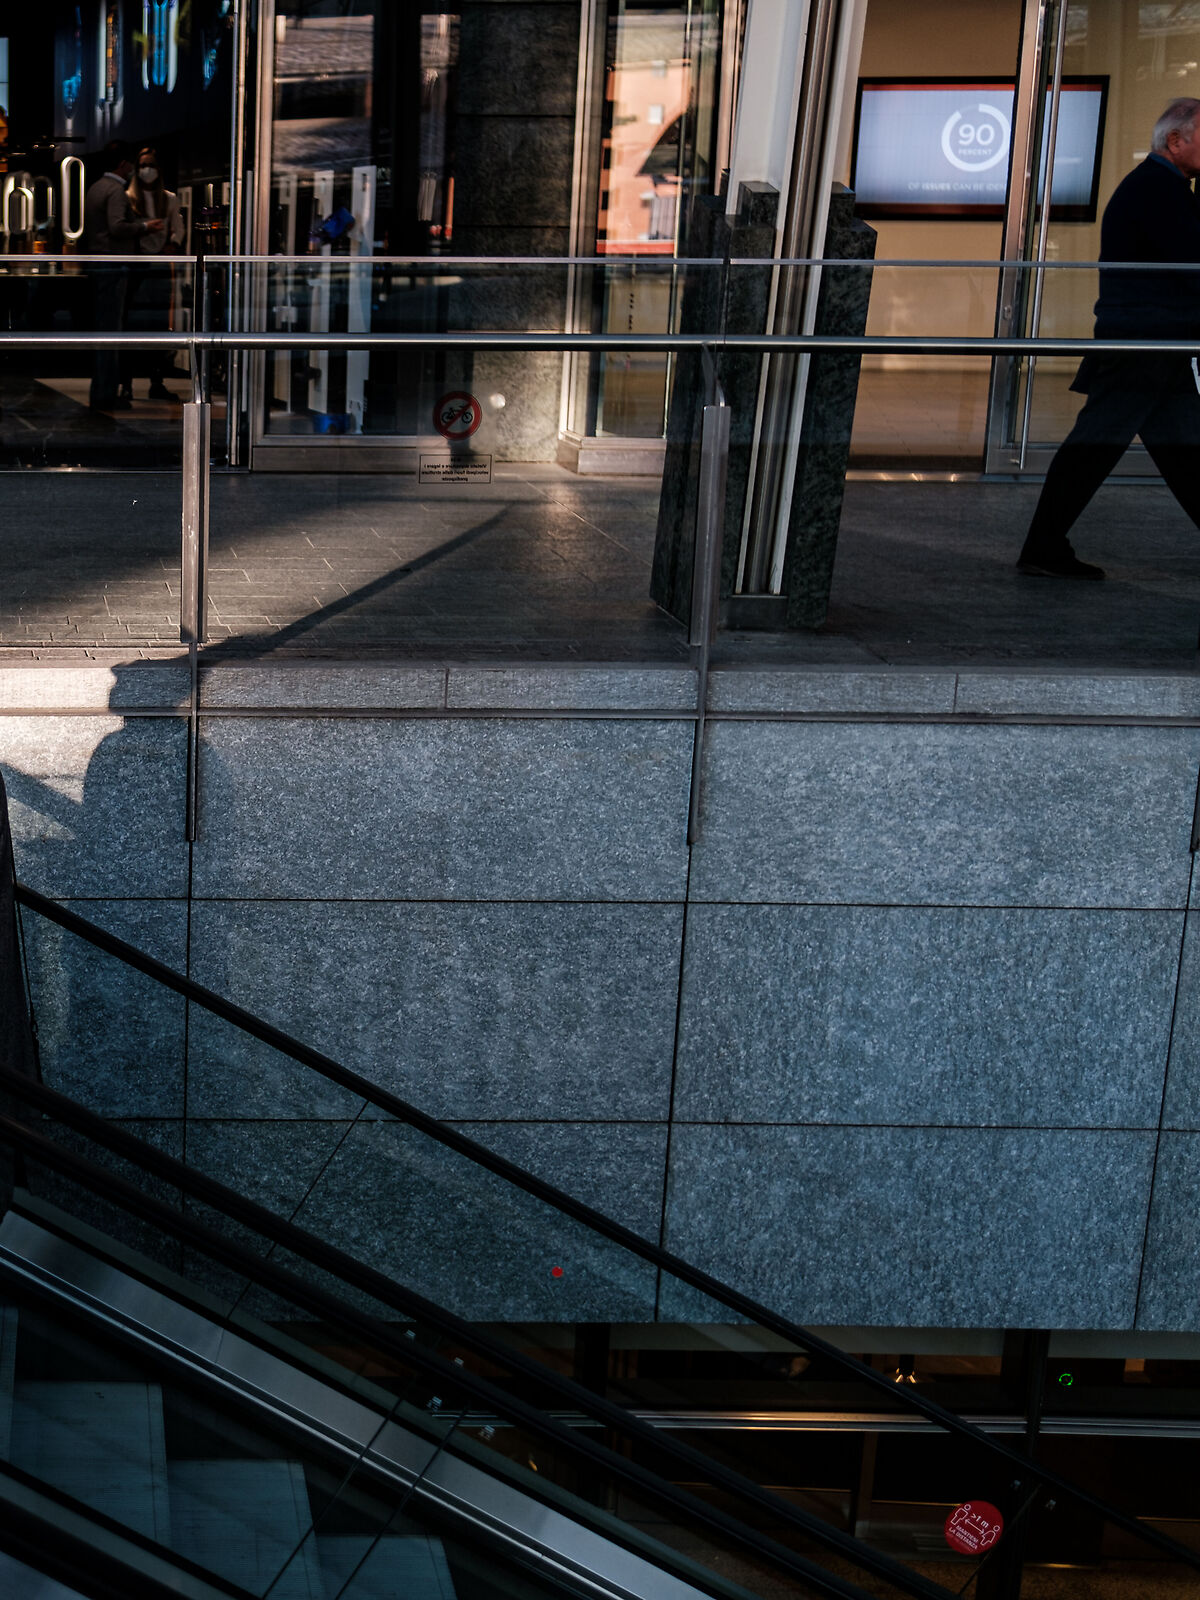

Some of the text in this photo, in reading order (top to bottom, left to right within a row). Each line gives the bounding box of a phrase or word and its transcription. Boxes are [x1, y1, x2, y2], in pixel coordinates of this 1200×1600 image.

[958, 123, 995, 146] 90
[958, 148, 993, 156] PERCENT
[907, 182, 921, 191] OF
[922, 182, 951, 191] ISSUES
[952, 182, 972, 191] CAN
[956, 1525, 978, 1542] MANTIENI
[956, 1532, 977, 1549] DISTANZA
